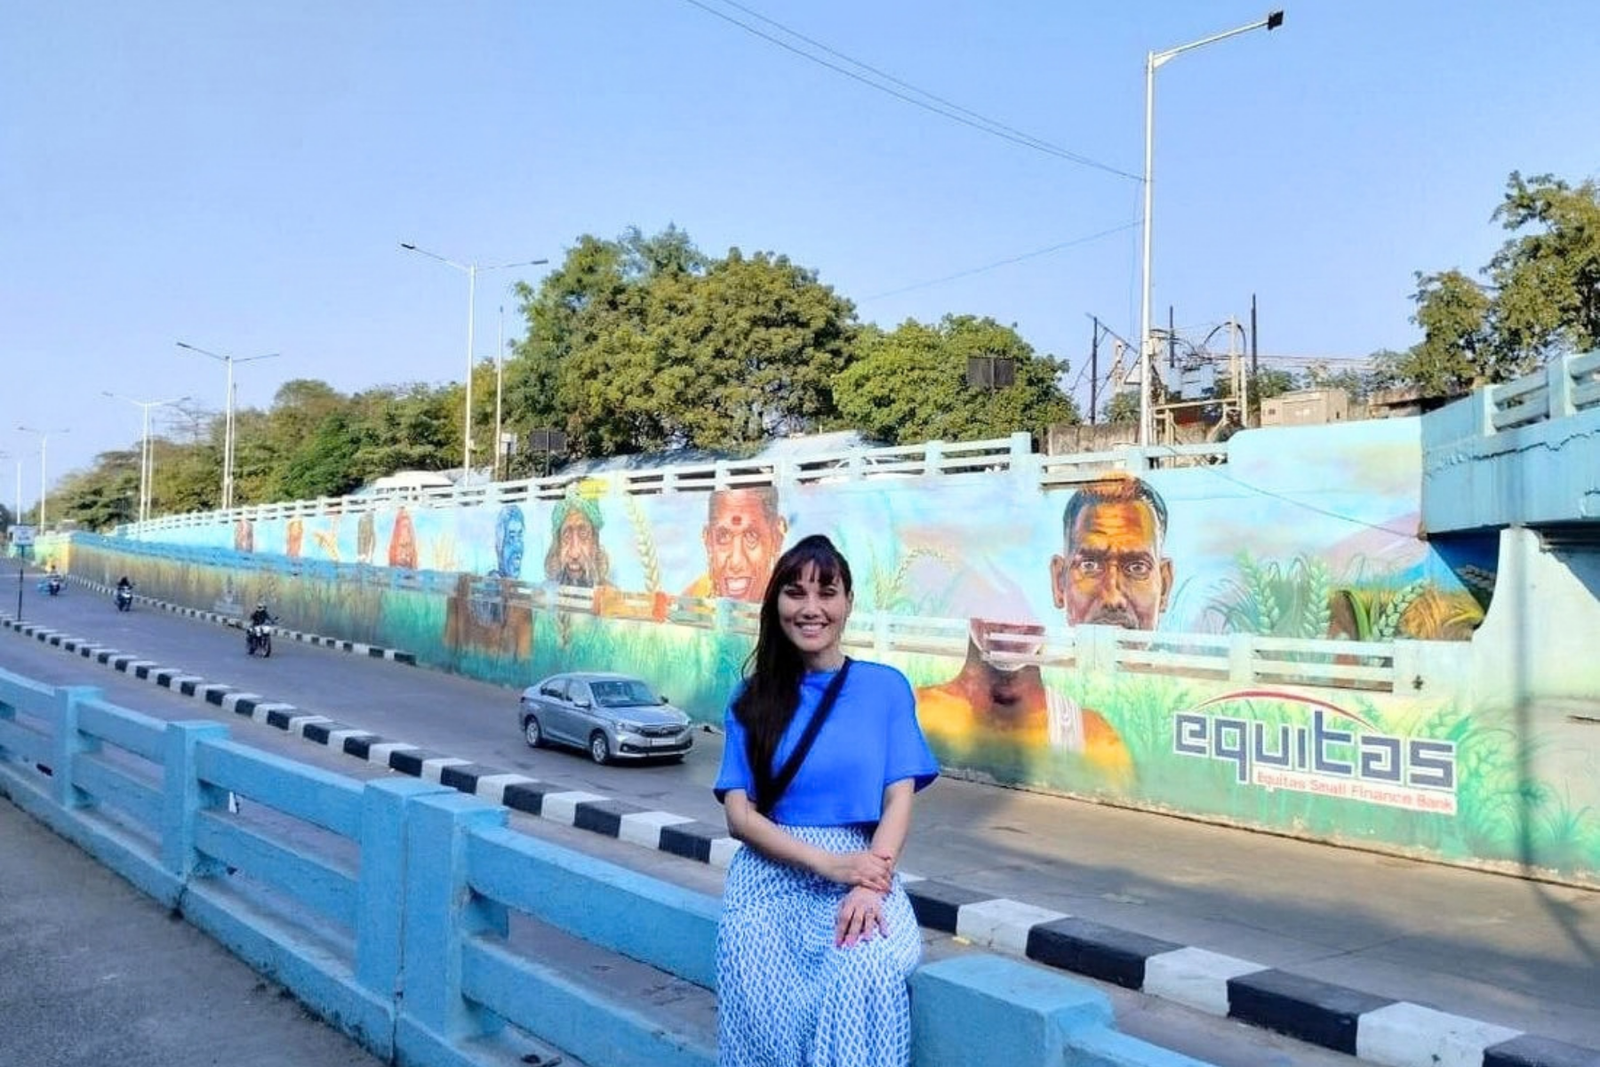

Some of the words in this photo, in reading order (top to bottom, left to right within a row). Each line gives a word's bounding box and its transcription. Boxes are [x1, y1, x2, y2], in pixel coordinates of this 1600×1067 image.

[1175, 711, 1454, 788] equitas
[1257, 771, 1306, 789] Equitas
[1310, 779, 1346, 795] Small
[1351, 784, 1413, 803] Finance
[1417, 794, 1453, 811] Bank
